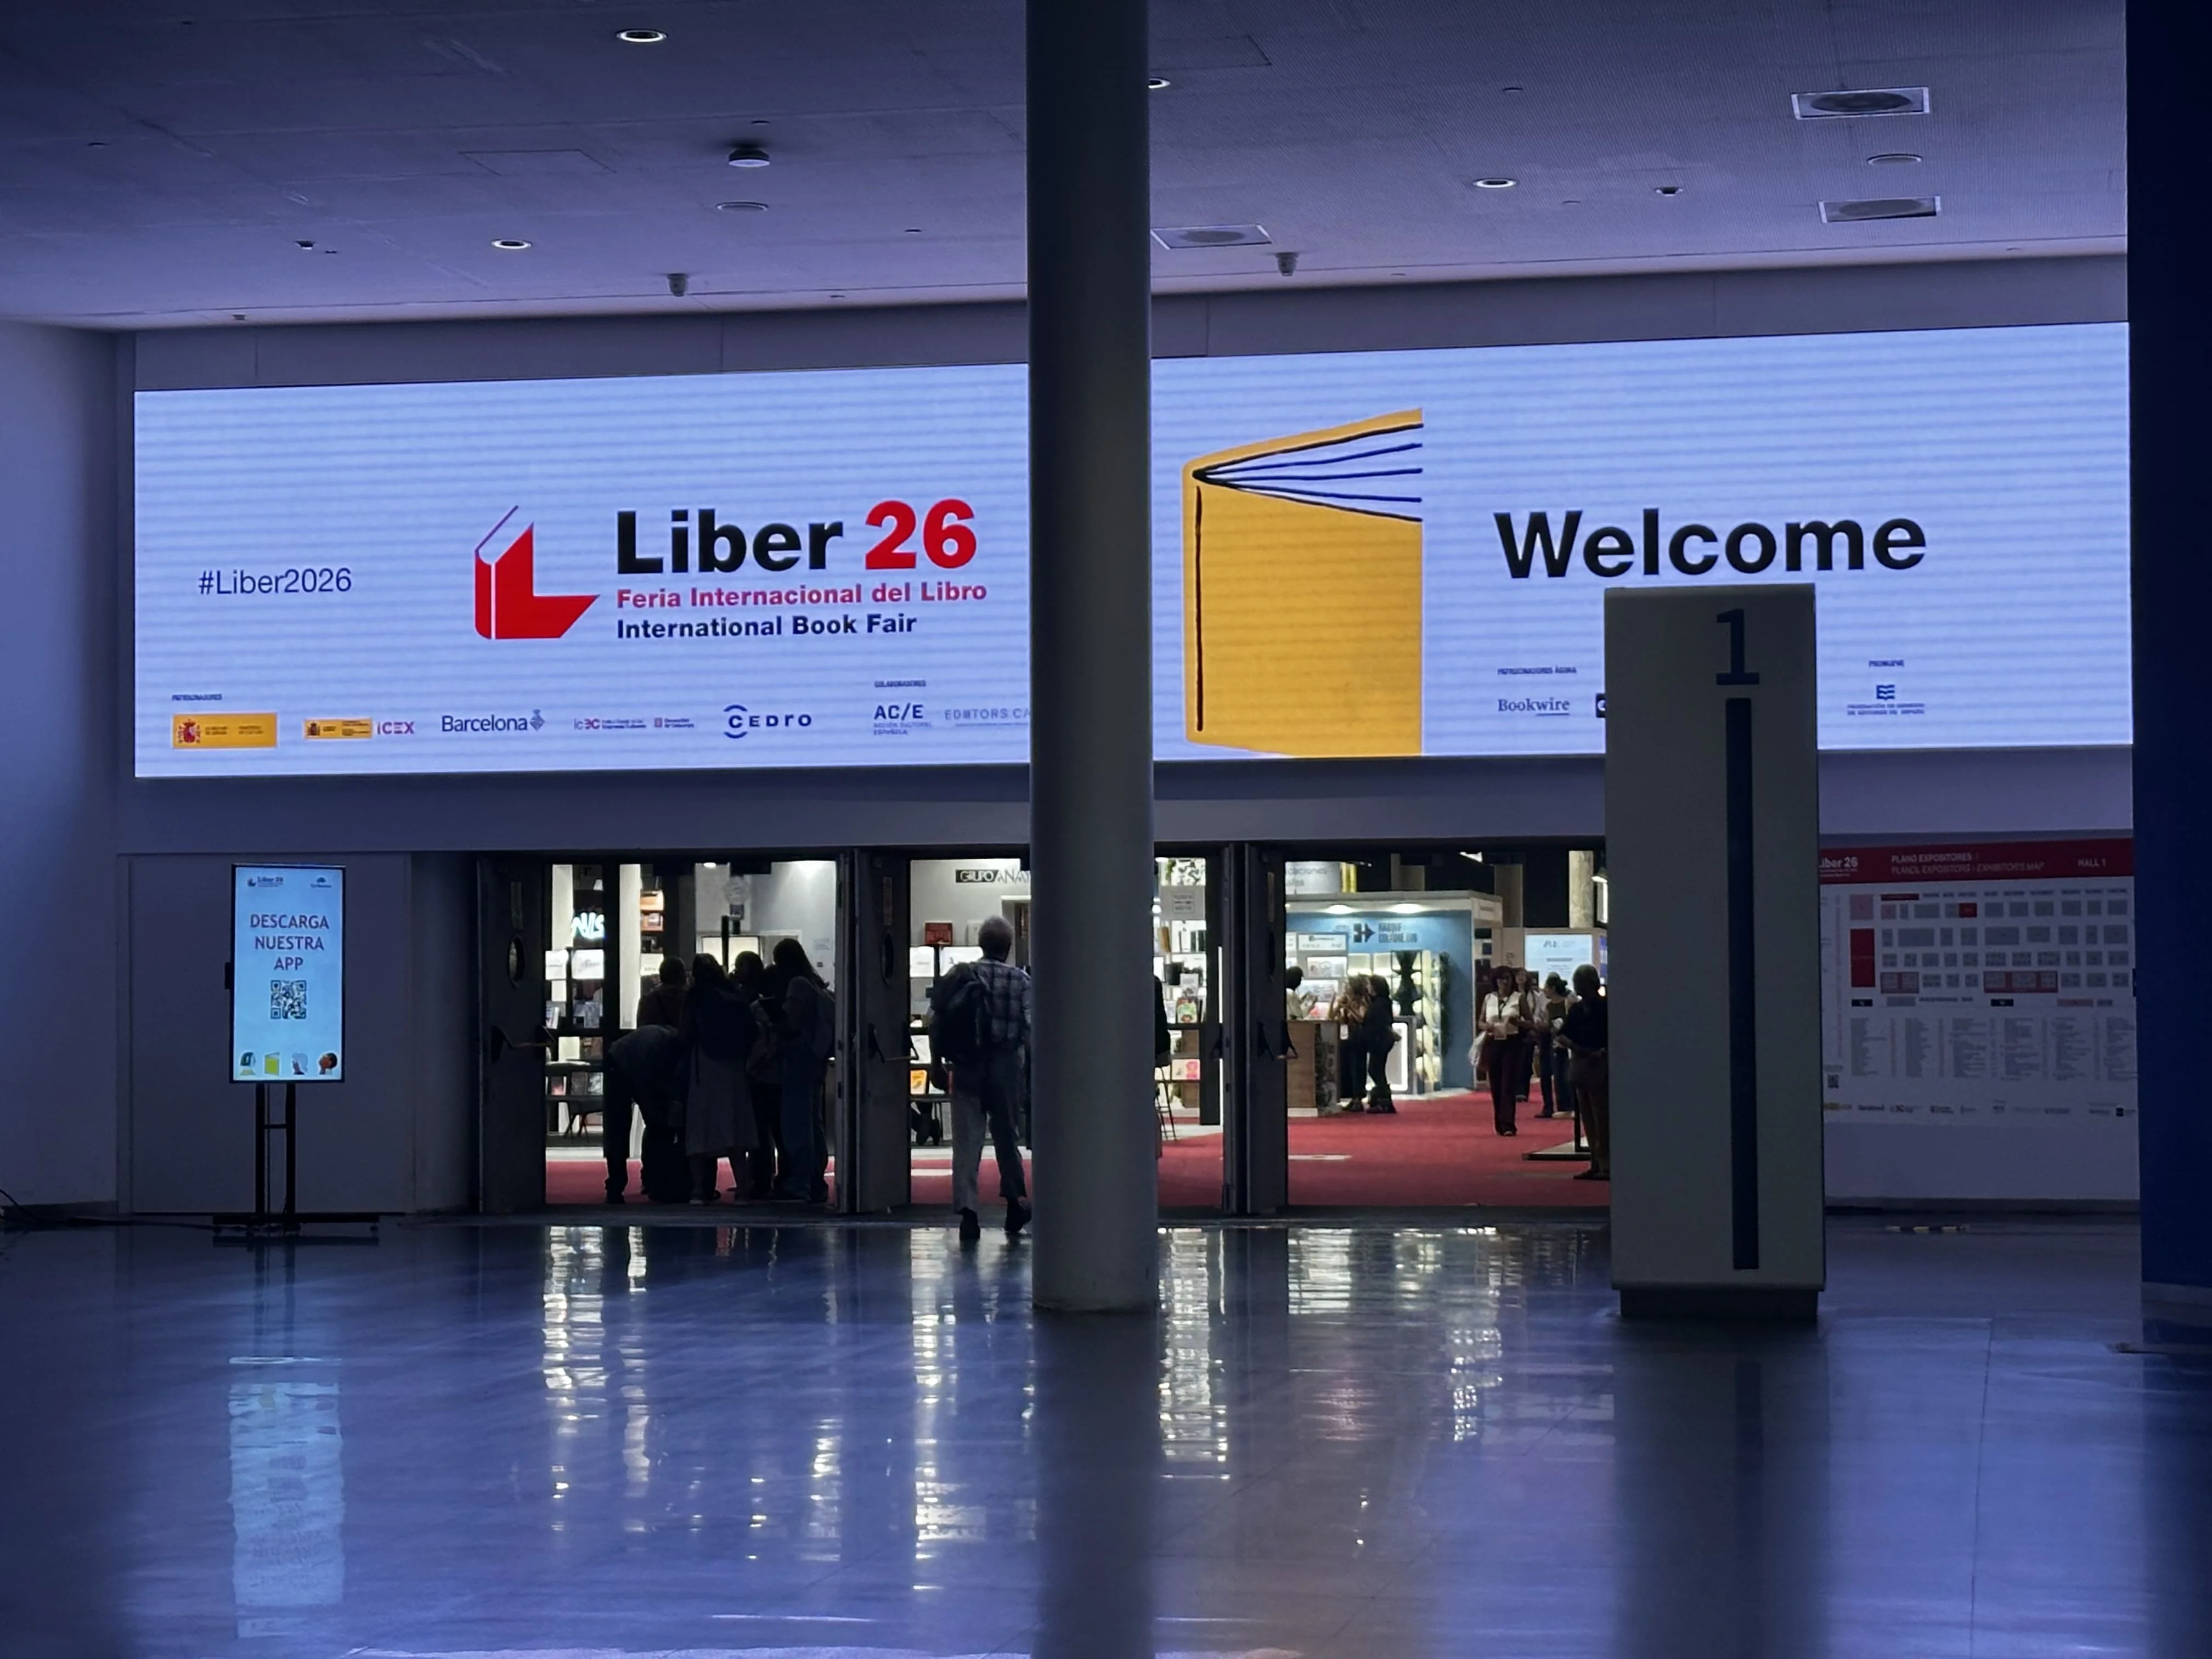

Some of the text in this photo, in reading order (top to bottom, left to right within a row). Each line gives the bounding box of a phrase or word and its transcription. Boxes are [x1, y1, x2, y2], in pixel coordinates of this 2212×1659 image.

[617, 499, 977, 574] Liber 26
[1493, 508, 1926, 579] Welcome
[199, 567, 352, 595] #Liber2026
[617, 581, 987, 608] Feria Internacional del Libro
[618, 613, 917, 639] International Book Fair
[1716, 608, 1760, 686] 1
[874, 703, 923, 721] AC/E
[1498, 697, 1570, 712] Bookwire
[442, 714, 528, 732] Barcelona
[1820, 857, 1842, 868] iber
[250, 914, 329, 929] DESCARGA
[255, 935, 325, 951] NUESTRA
[274, 956, 303, 971] APP
